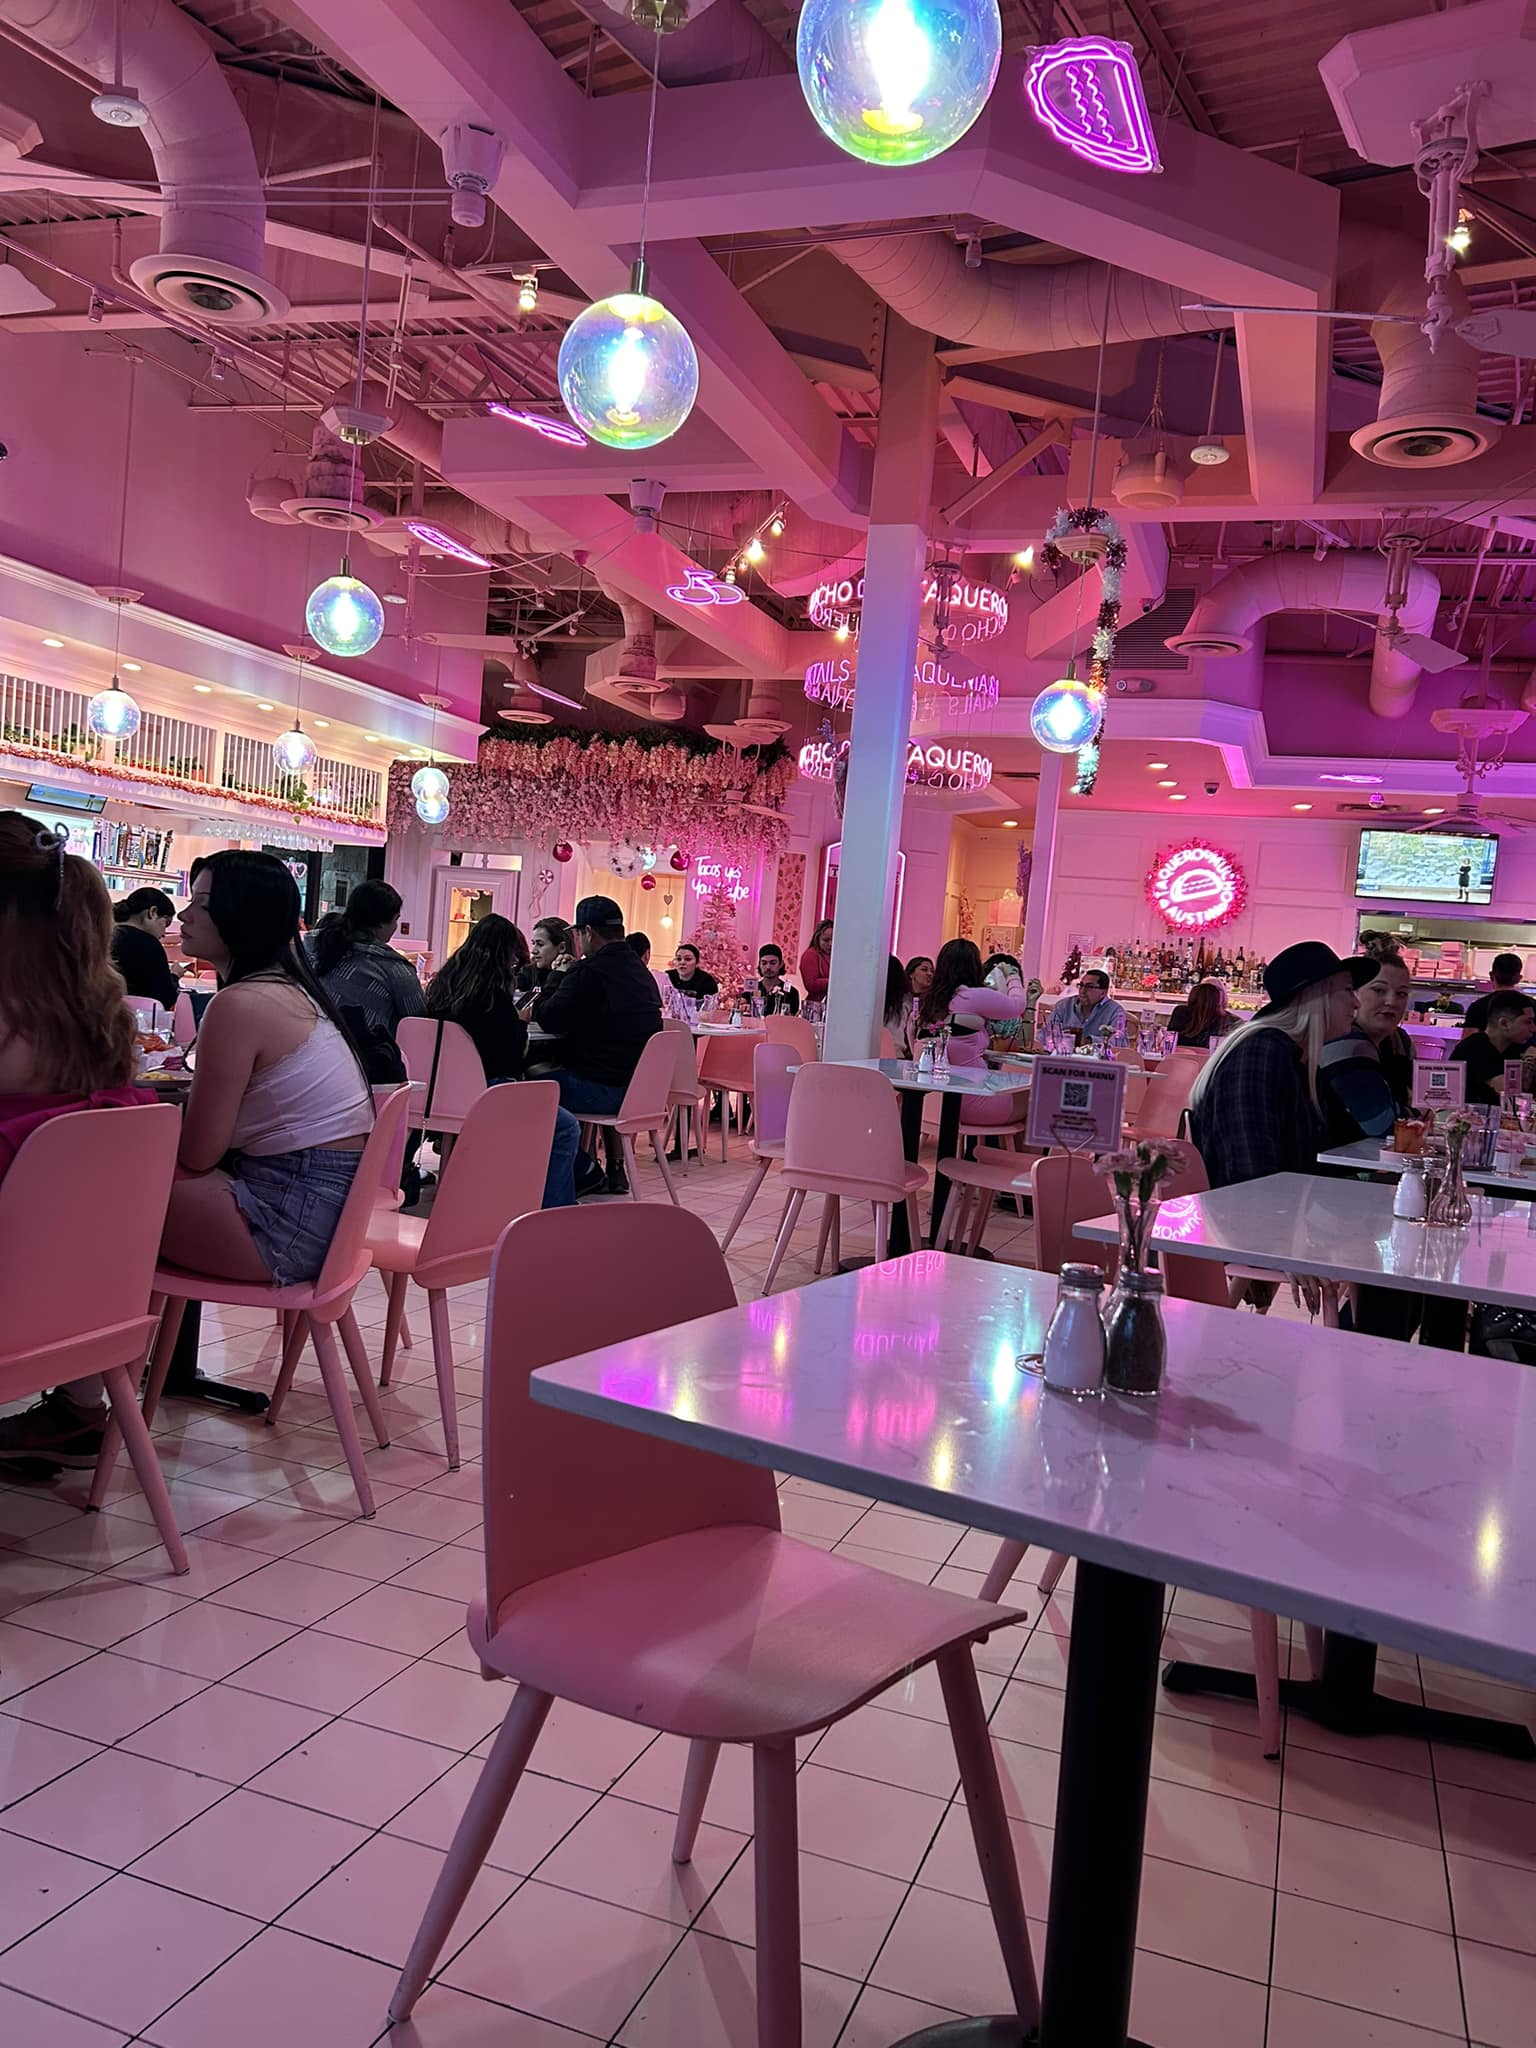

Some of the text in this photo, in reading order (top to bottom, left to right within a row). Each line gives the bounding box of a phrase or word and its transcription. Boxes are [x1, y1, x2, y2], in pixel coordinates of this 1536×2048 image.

[921, 580, 1007, 618] AQUERO
[907, 744, 989, 777] AQUERO
[1042, 1067, 1116, 1081] SCAN FOR MENU
